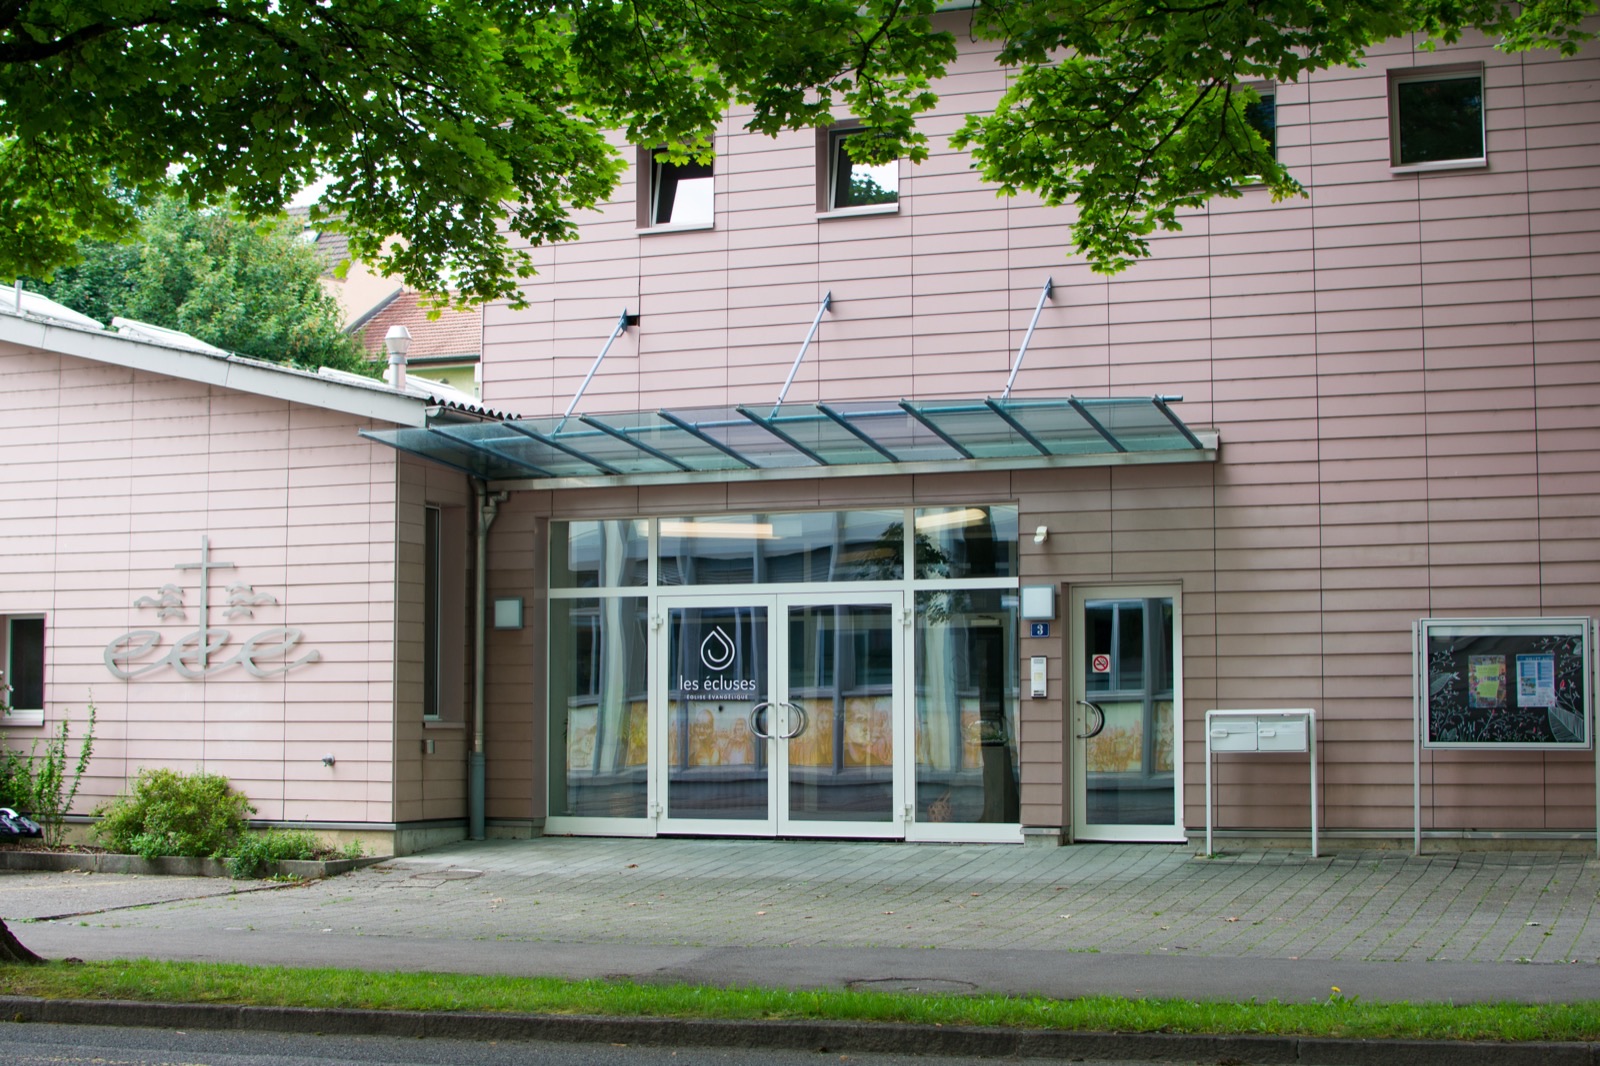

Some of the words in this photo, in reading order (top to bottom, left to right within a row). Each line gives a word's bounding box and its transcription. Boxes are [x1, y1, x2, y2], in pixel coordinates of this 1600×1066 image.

[1037, 624, 1044, 635] 3
[680, 674, 699, 691] les
[703, 674, 756, 691] écluses
